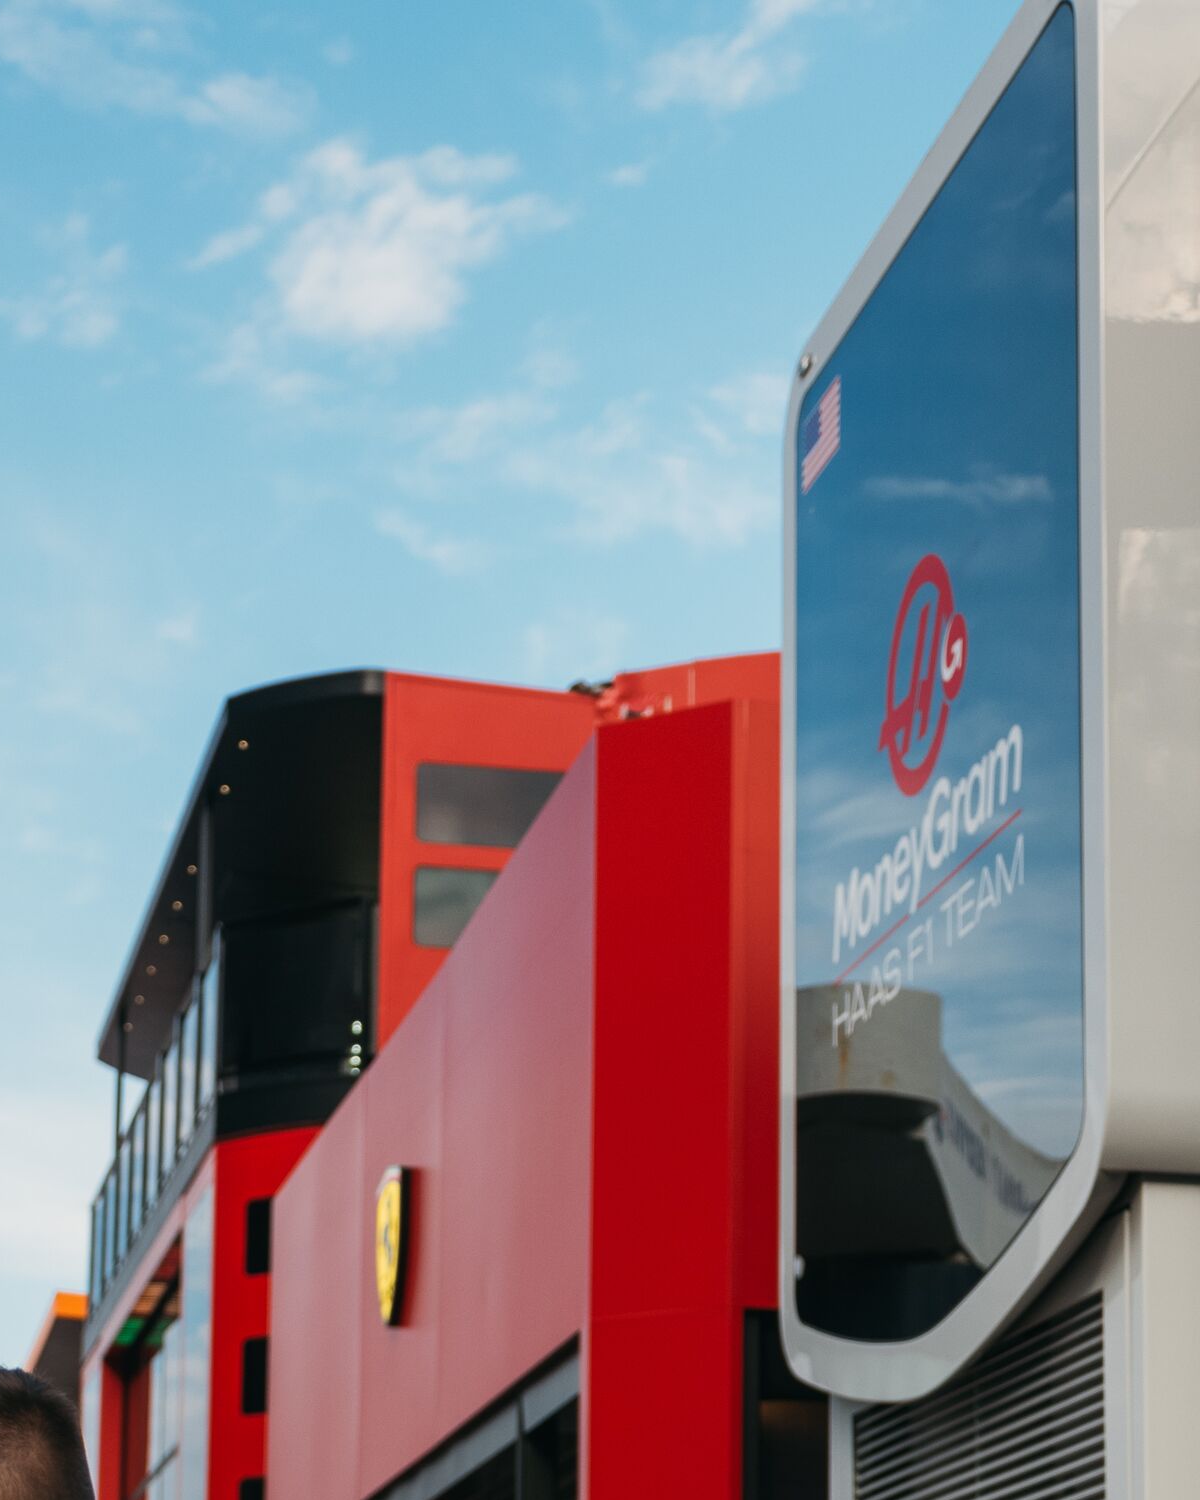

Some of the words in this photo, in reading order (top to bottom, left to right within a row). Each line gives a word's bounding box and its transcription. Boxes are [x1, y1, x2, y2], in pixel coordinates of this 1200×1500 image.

[831, 723, 1023, 964] MoneyGram
[831, 946, 902, 1047] HAAS
[907, 916, 935, 981] F1
[939, 832, 1025, 947] TEAM
